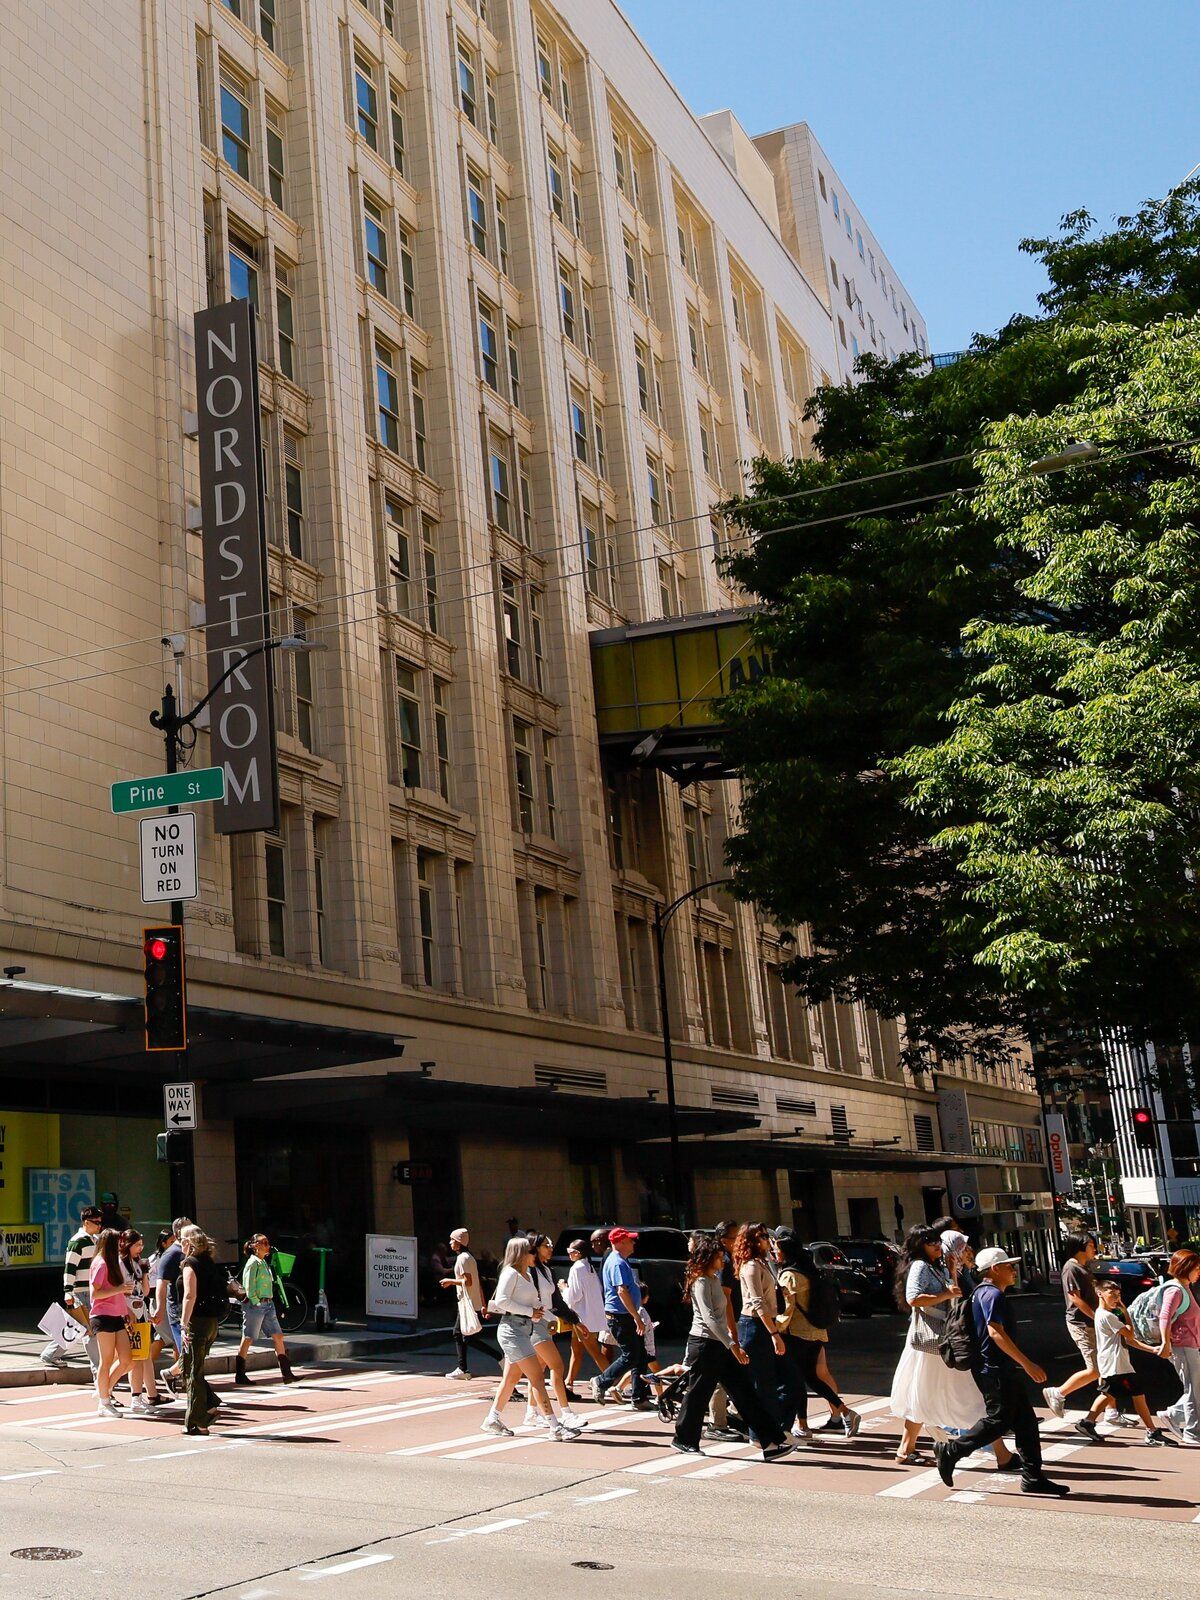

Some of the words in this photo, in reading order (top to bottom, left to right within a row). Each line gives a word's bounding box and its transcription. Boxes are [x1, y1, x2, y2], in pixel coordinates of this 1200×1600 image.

[206, 322, 262, 806] NORDSTROM
[129, 785, 165, 804] Pine
[187, 782, 201, 795] St
[155, 823, 180, 842] NO
[151, 843, 184, 858] TURN
[159, 862, 177, 875] ON
[157, 878, 181, 893] RED
[168, 1087, 191, 1099] ONE
[168, 1099, 191, 1111] WAY
[1050, 1132, 1064, 1174] Optum
[32, 1173, 73, 1192] IT'S
[73, 1173, 91, 1192] A
[4, 1232, 41, 1245] AVINGS!
[373, 1264, 409, 1273] CURBSIDE
[377, 1272, 405, 1281] PICKUP
[381, 1280, 402, 1288] ONLY
[384, 1299, 409, 1307] PARKING
